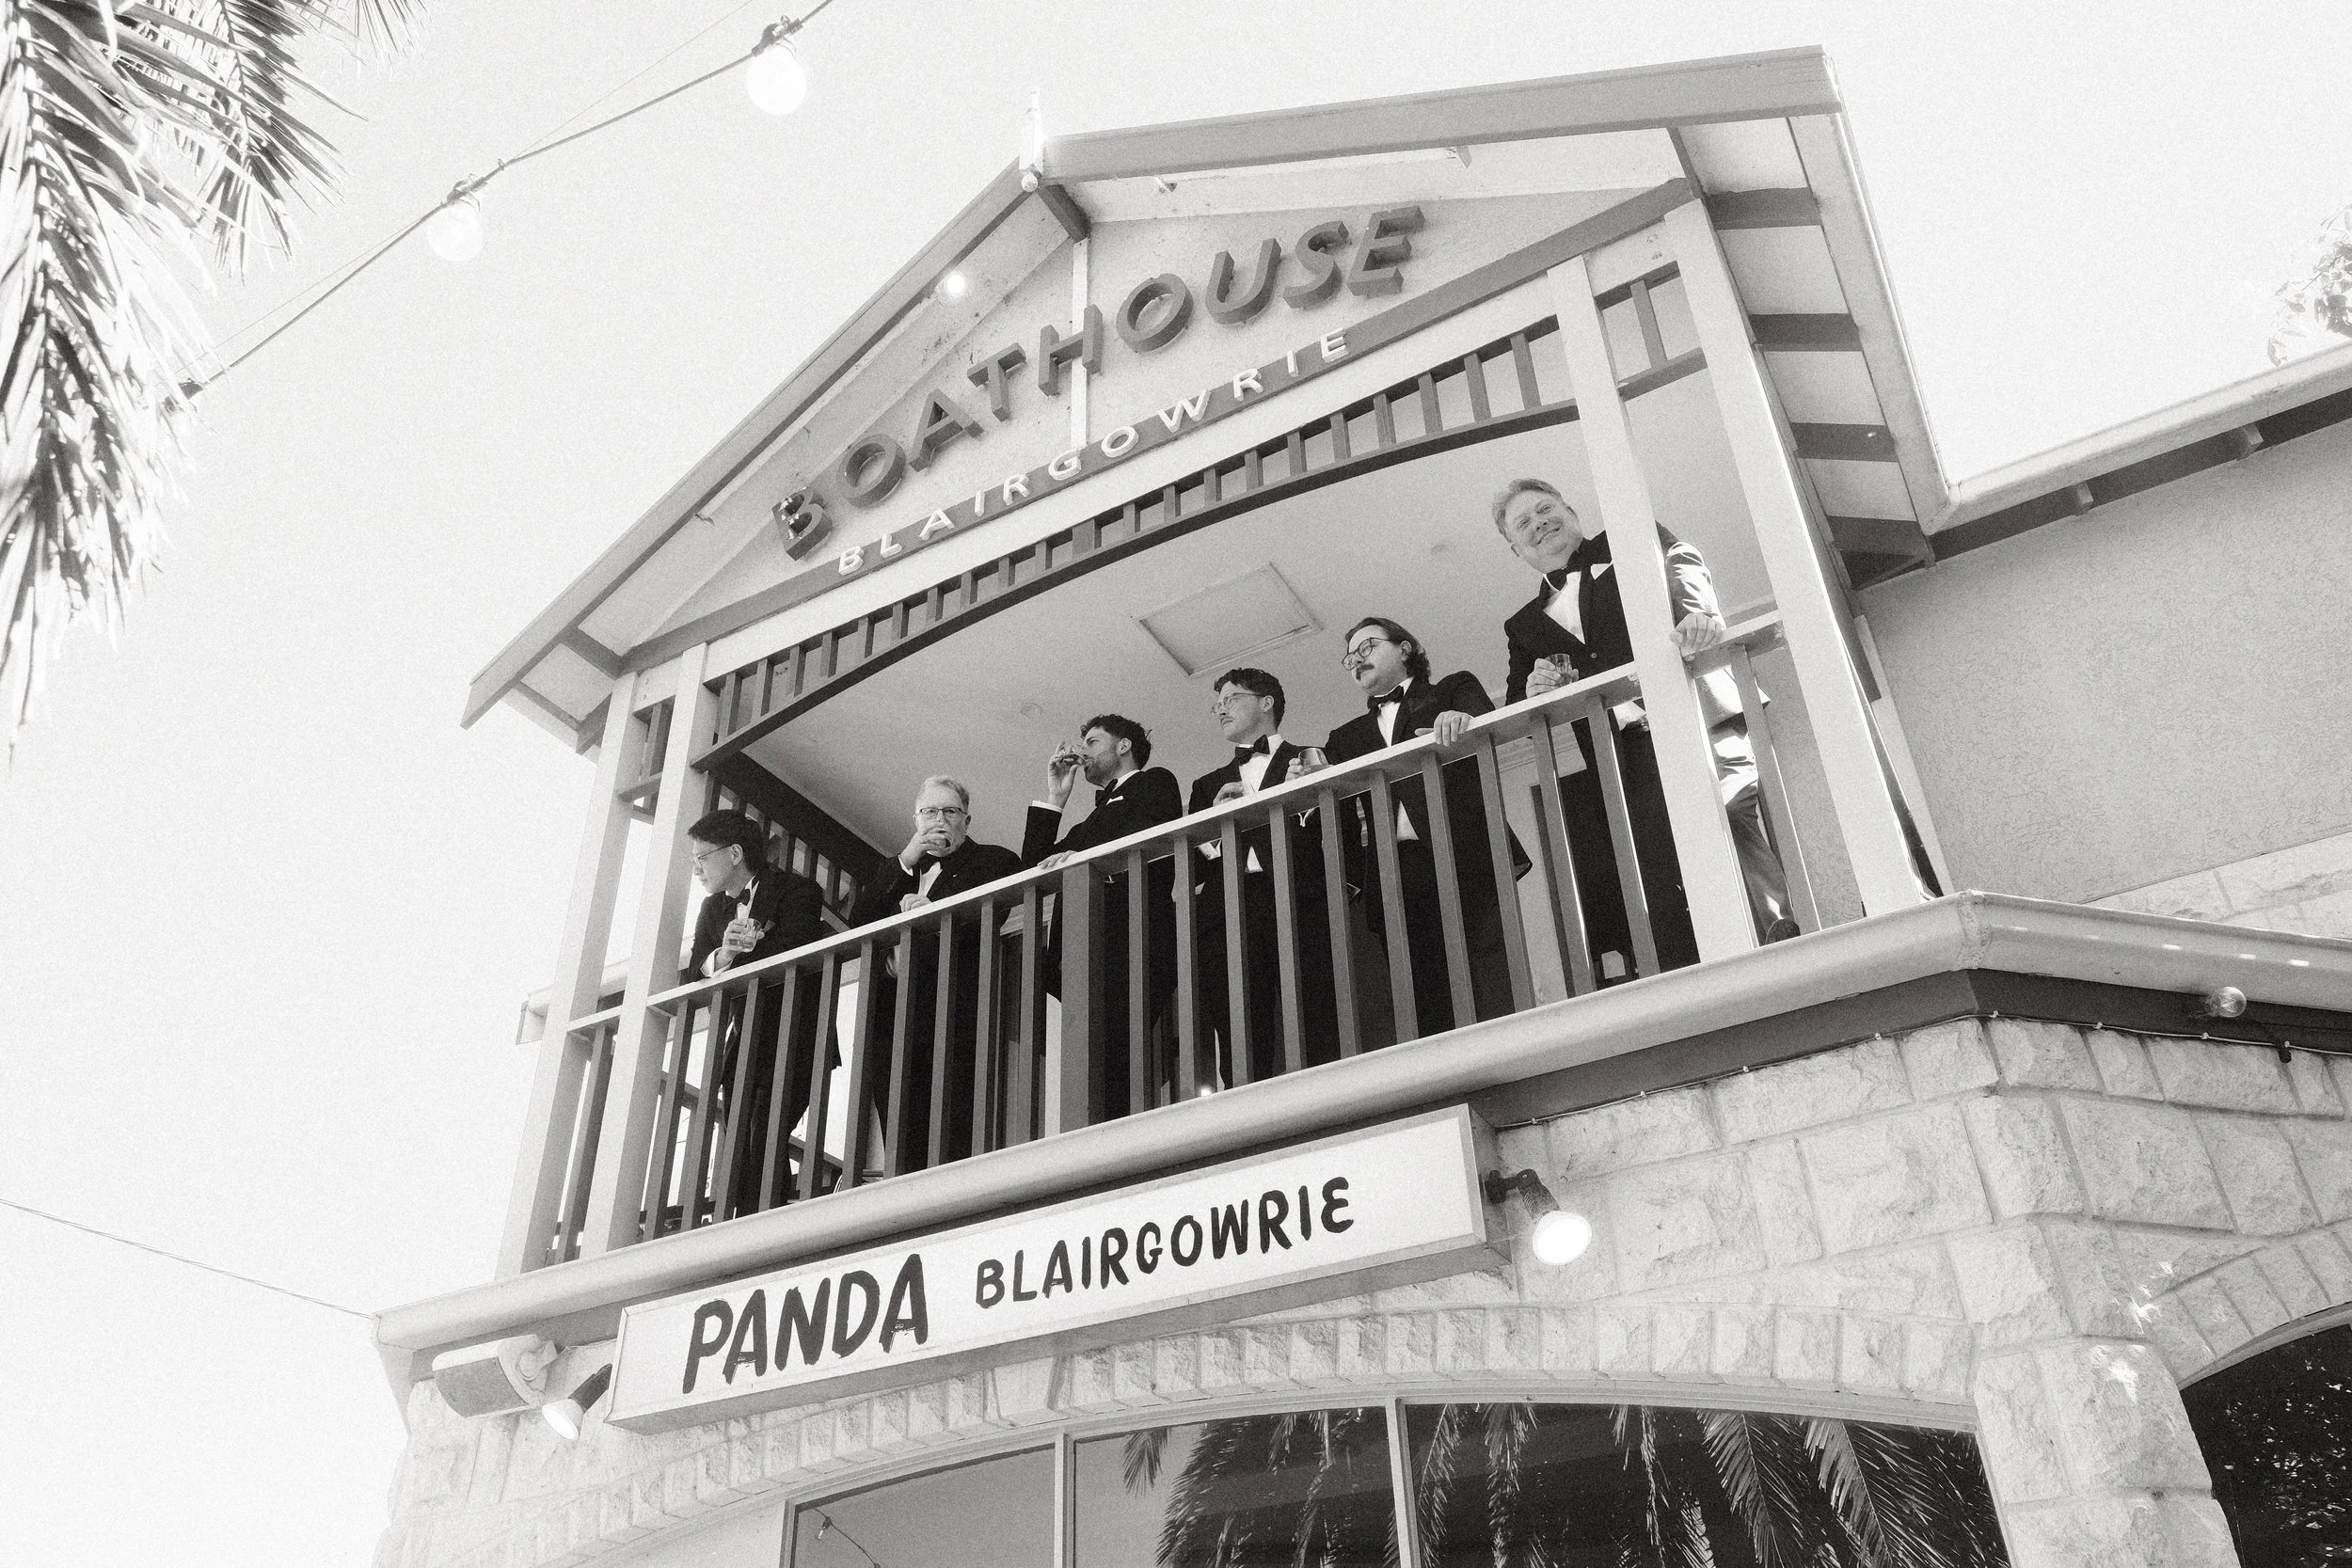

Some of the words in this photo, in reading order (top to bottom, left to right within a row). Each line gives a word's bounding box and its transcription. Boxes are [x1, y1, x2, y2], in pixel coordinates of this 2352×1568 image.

[771, 206, 1425, 561] BOATHOUSE
[837, 327, 1350, 577] BLAIRGOWRIE
[682, 1254, 928, 1394] PANDA
[976, 1177, 1354, 1308] BLAIRGOWRIE
